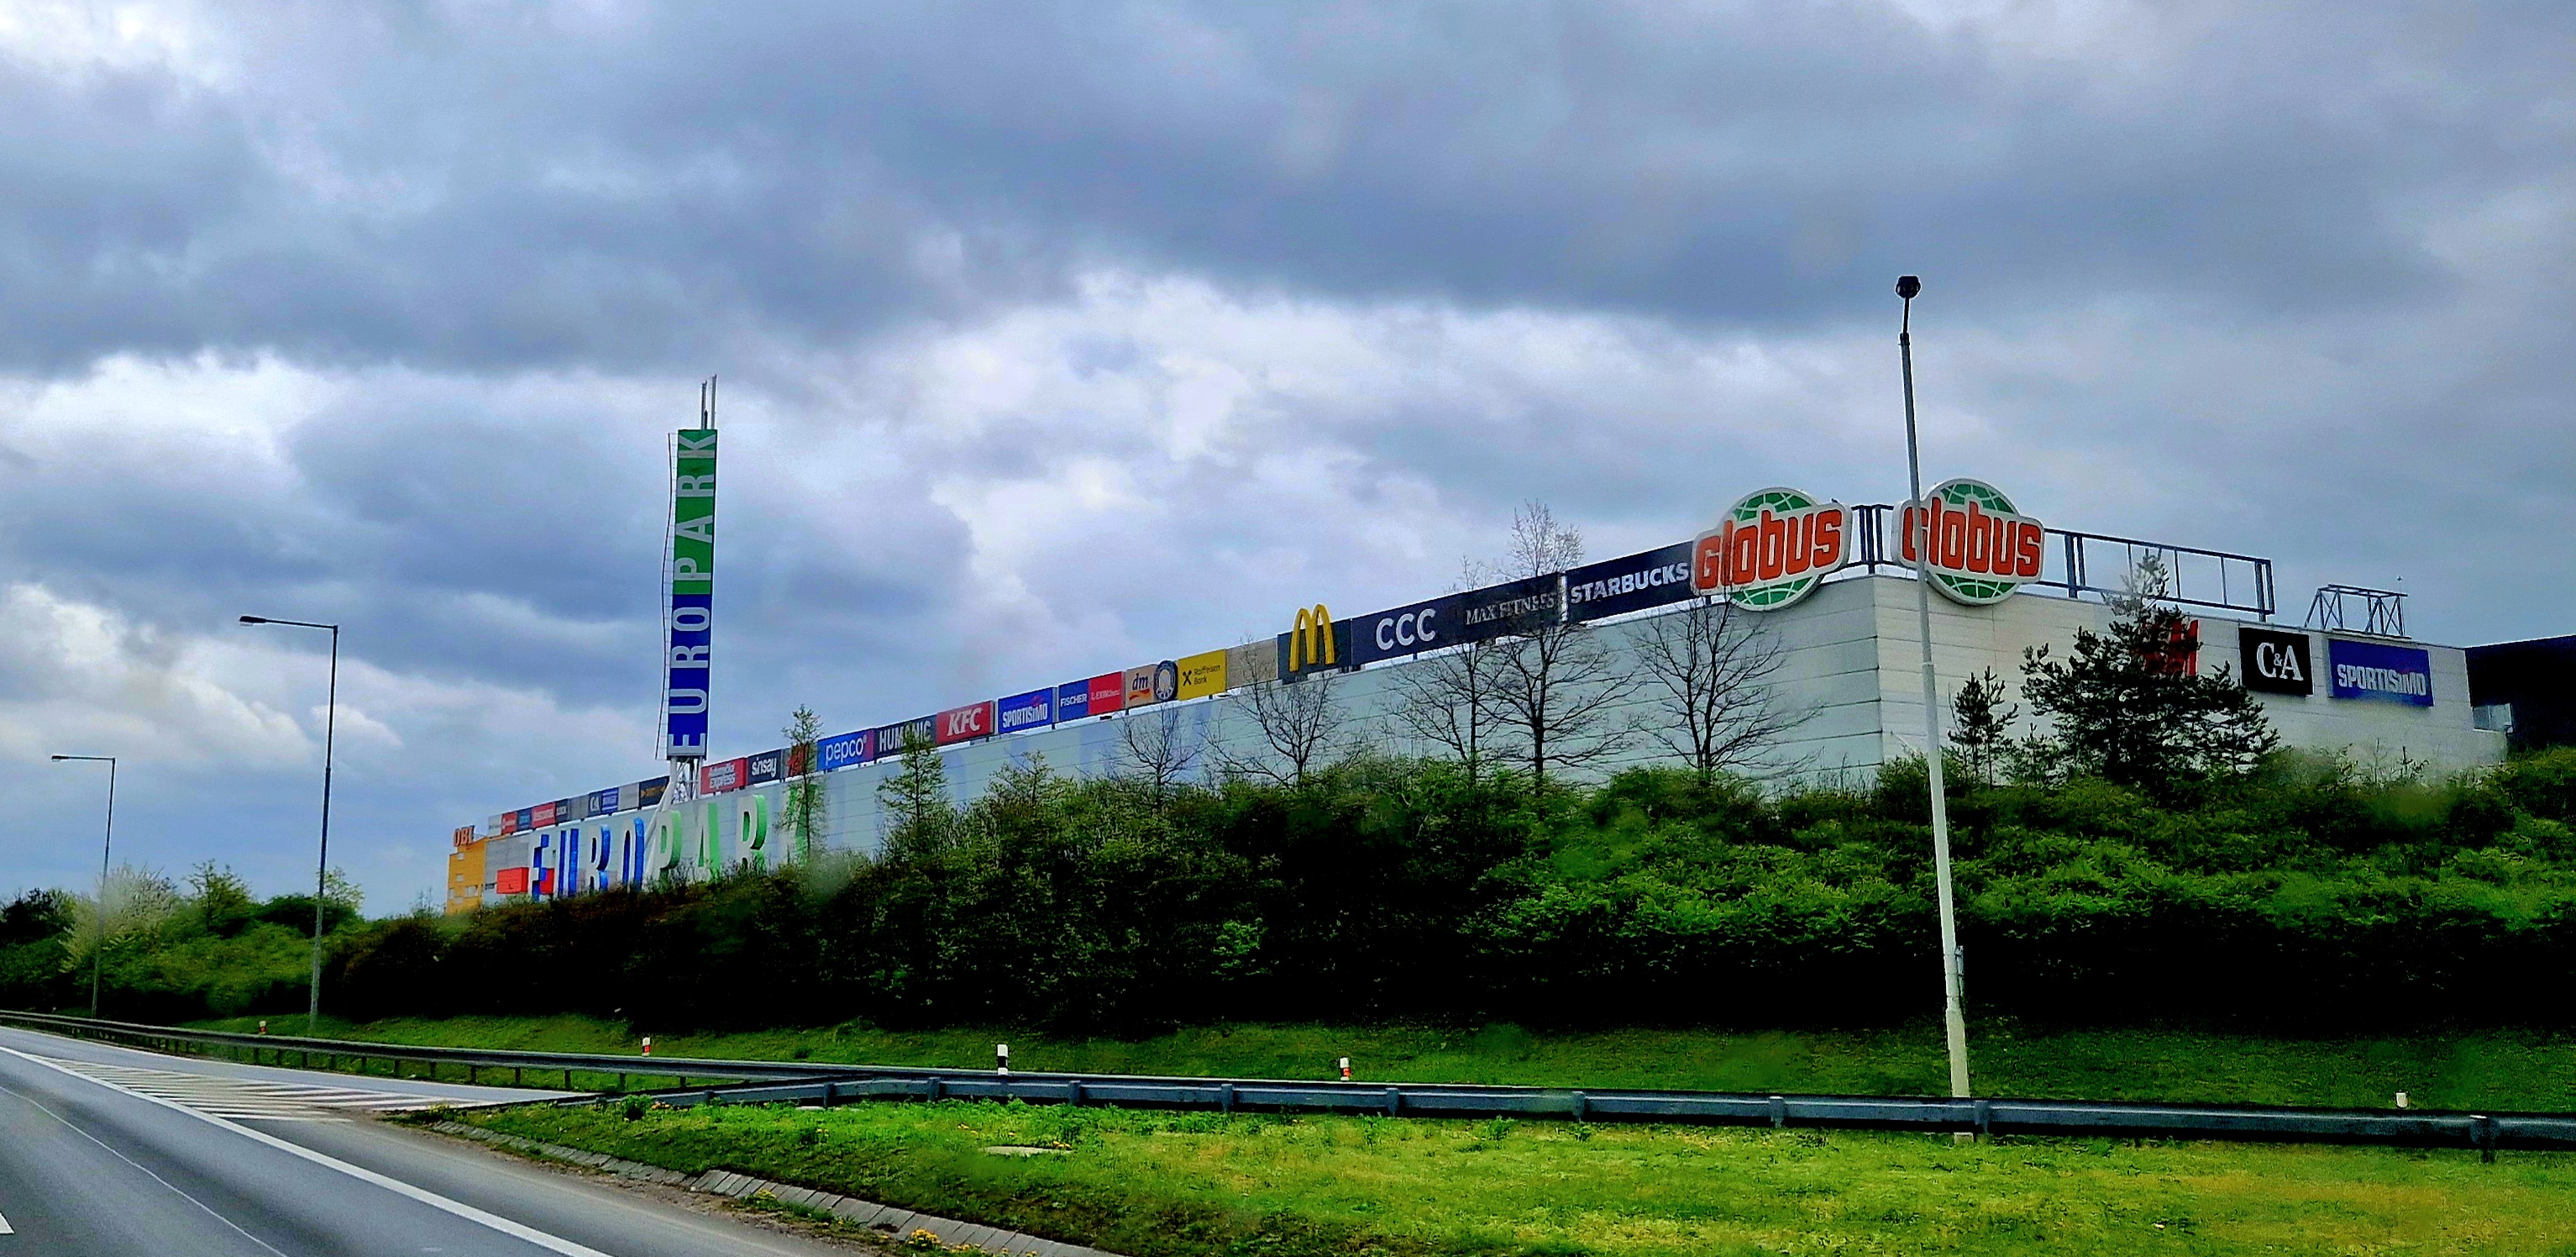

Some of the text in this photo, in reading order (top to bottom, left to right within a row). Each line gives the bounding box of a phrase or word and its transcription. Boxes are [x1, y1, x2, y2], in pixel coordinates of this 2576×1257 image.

[1696, 509, 1843, 590] Globus
[668, 431, 716, 755] EUROPARK
[1571, 562, 1690, 604] STARBUCKS
[1376, 608, 1436, 650] CCC
[1465, 603, 1498, 626] MAX
[2257, 642, 2304, 681] C&A
[1132, 672, 1149, 691] dm
[1060, 693, 1088, 707] FISCHER
[947, 707, 983, 737] KFC
[751, 757, 778, 779] sinsay
